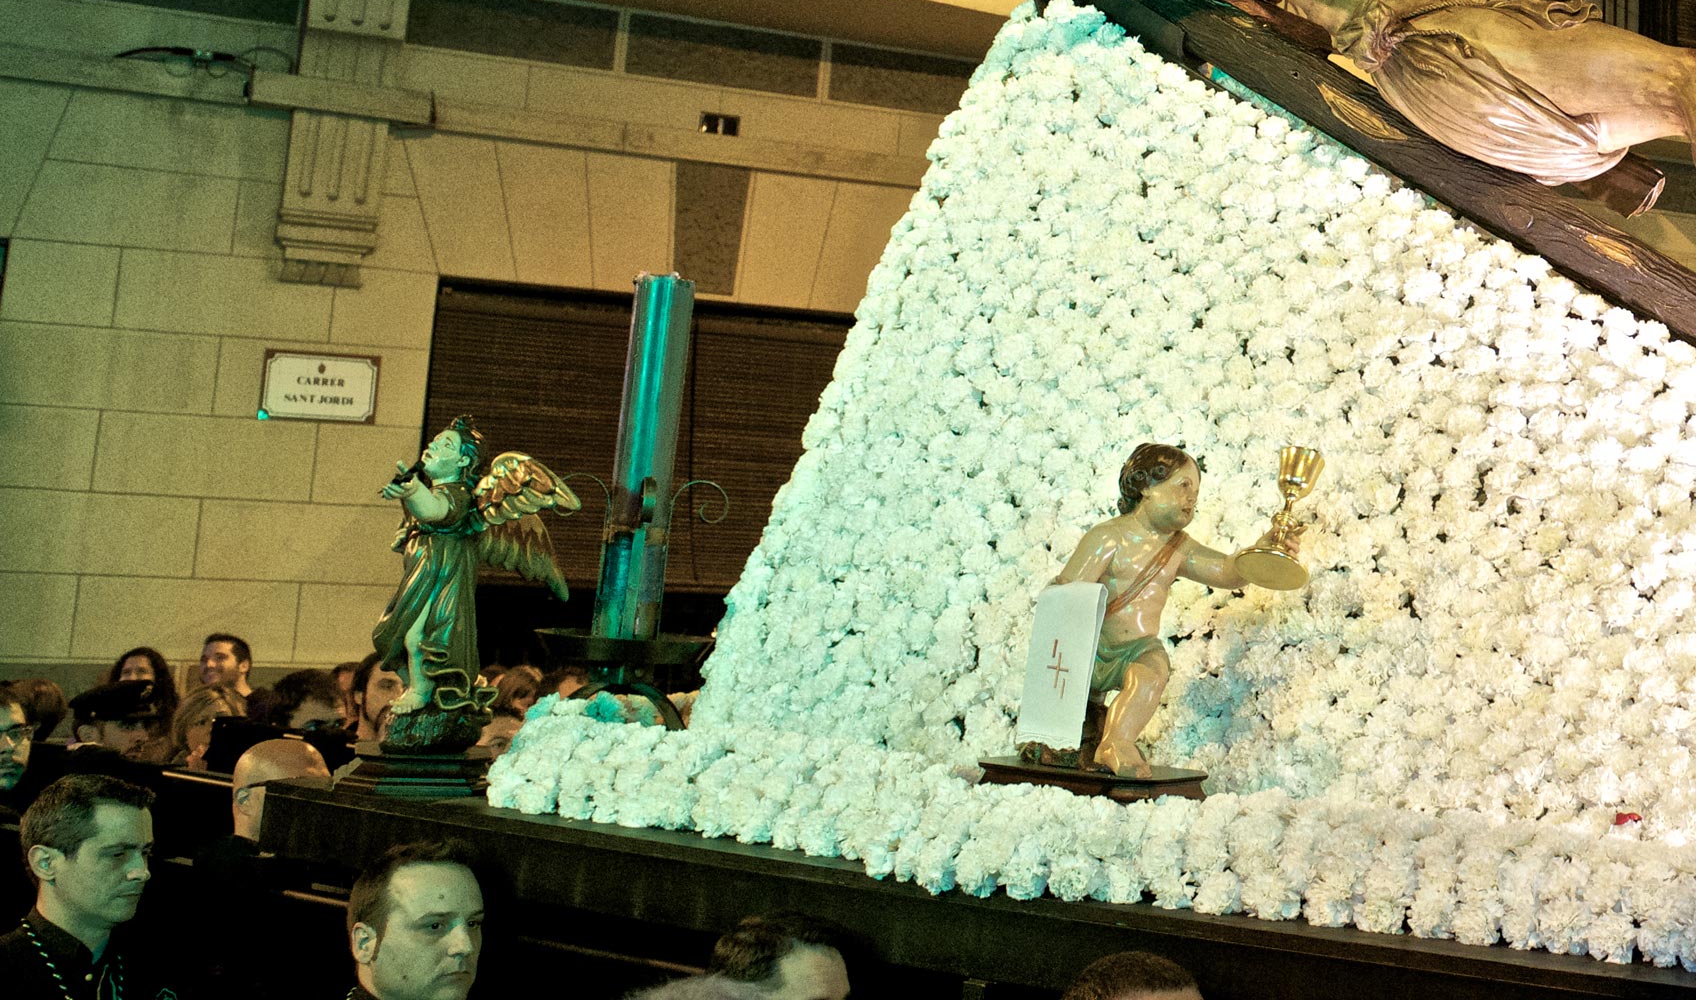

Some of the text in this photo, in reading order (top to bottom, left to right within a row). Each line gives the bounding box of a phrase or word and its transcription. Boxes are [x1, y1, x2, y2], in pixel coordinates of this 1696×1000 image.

[296, 376, 345, 387] CARRER
[284, 393, 354, 405] SANT JORDI
